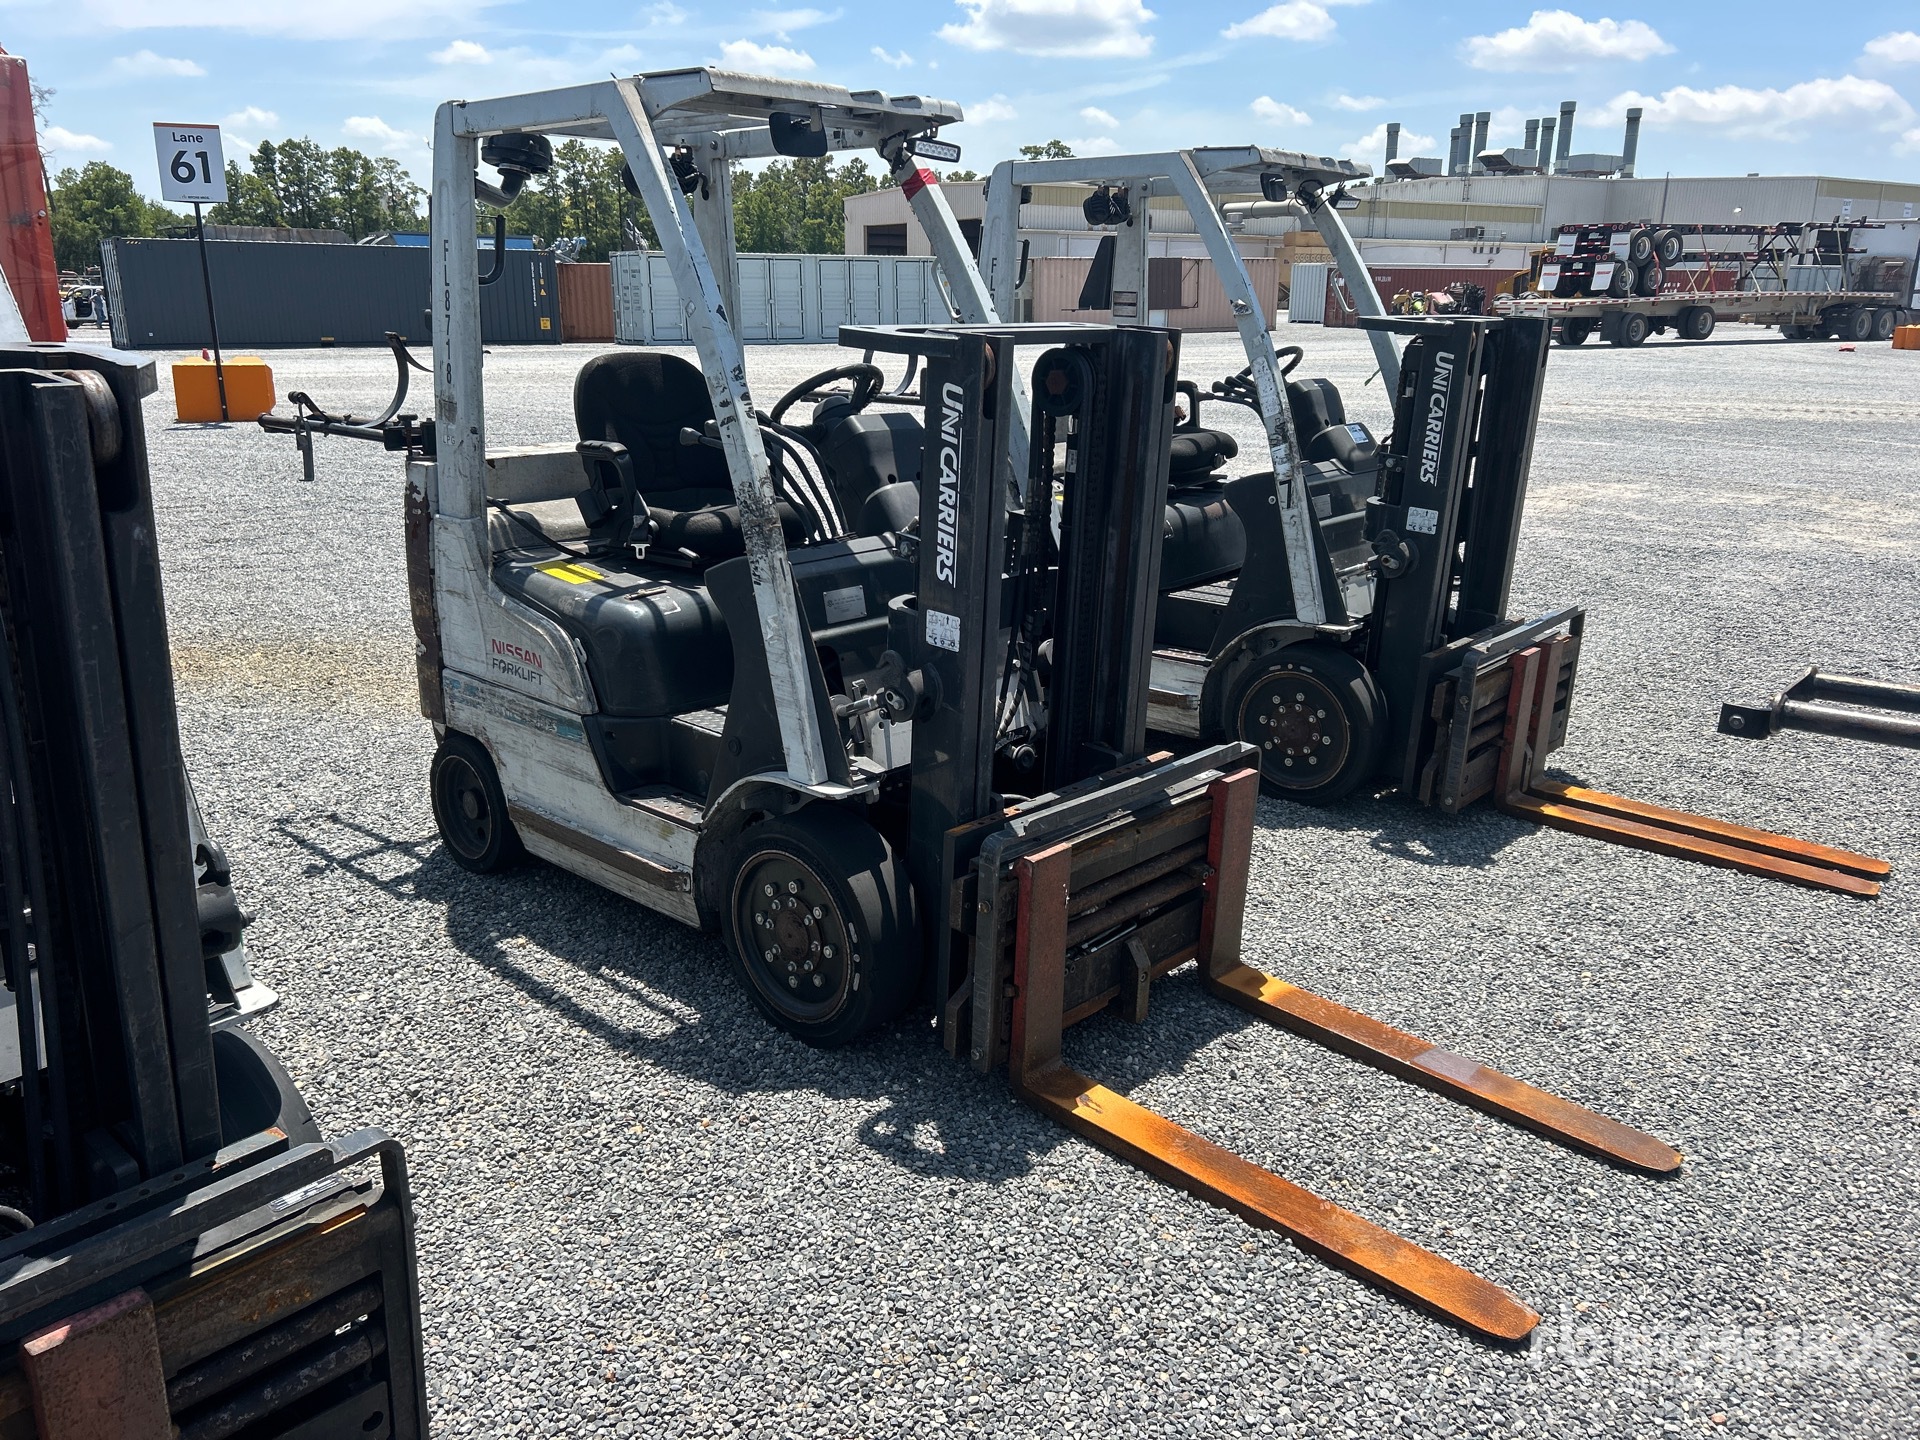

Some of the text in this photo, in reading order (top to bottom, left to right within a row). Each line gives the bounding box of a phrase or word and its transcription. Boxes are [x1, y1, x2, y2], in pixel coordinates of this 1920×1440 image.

[171, 131, 204, 143] Lane
[170, 150, 212, 184] 61
[443, 239, 453, 385] FL8718
[442, 435, 456, 445] LPG
[491, 638, 543, 669] NISSAN
[492, 657, 544, 686] FORKLIFT
